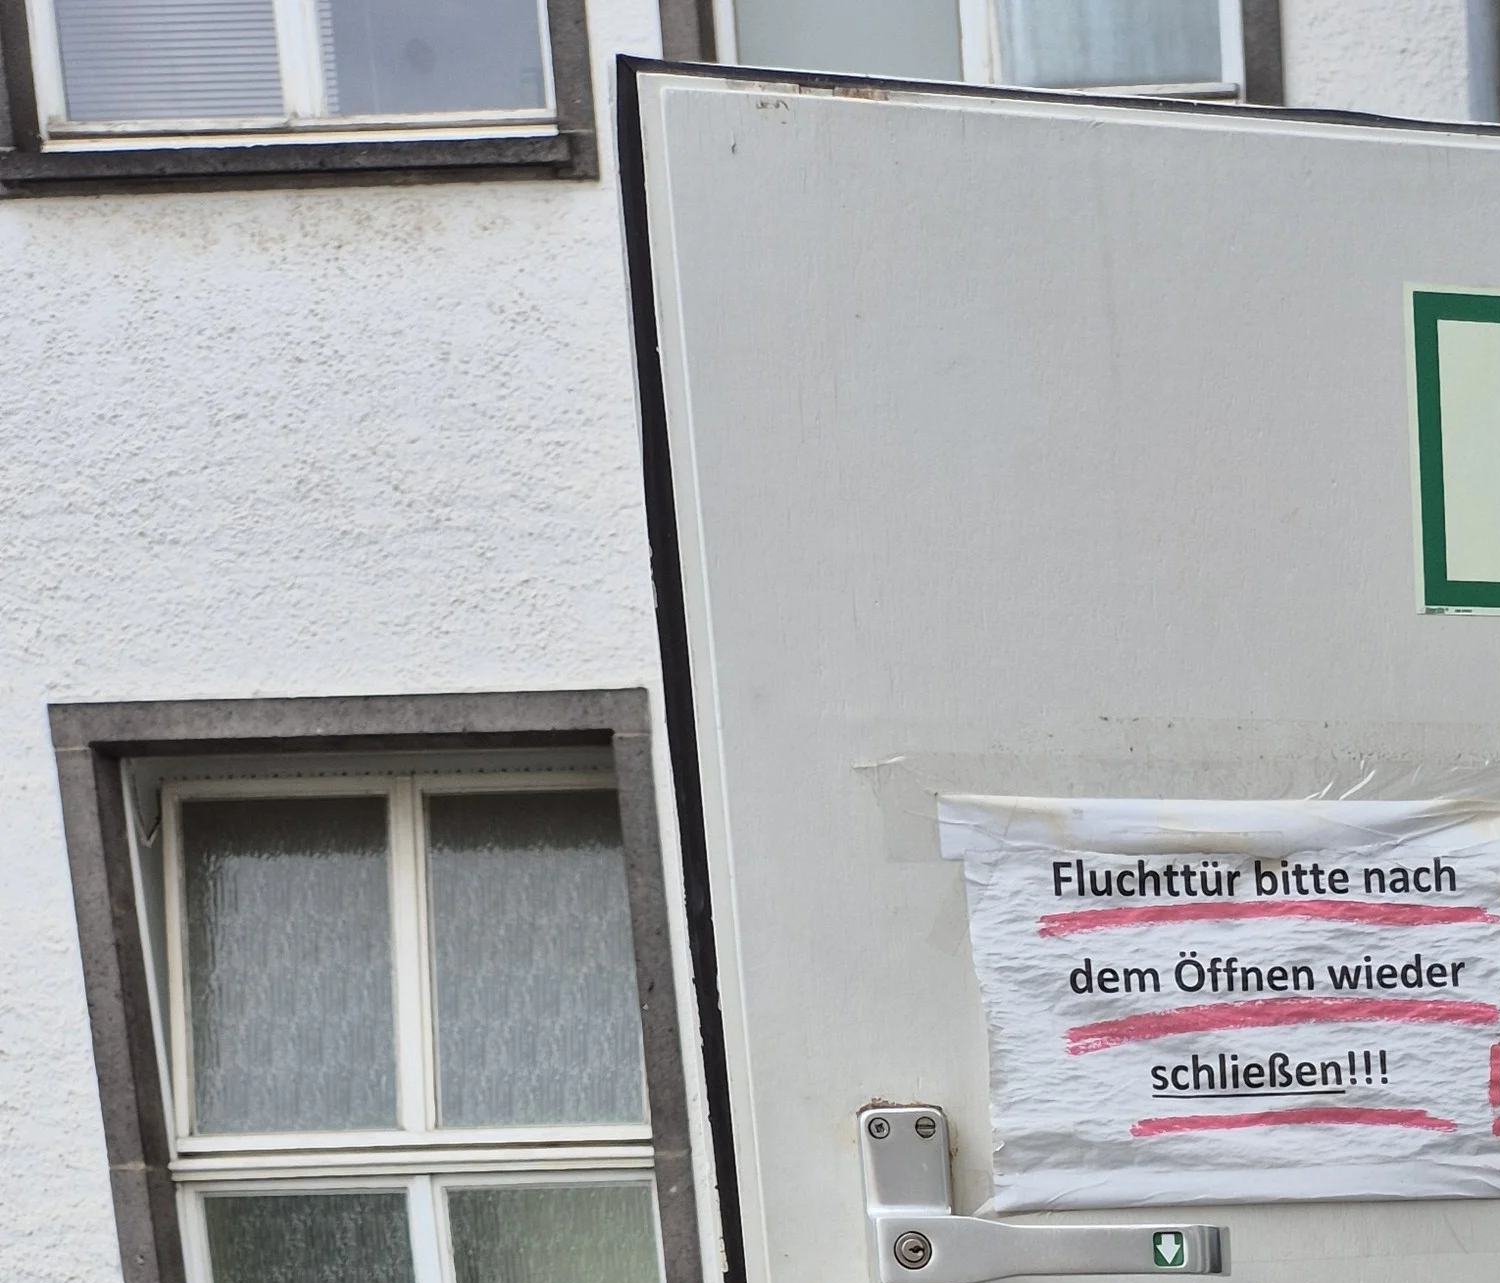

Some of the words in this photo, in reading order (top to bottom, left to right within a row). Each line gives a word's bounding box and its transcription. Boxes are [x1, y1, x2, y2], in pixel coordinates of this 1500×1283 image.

[1052, 860, 1241, 897] Fluchttür
[1254, 860, 1350, 897] bitte
[1363, 857, 1457, 894] nach
[1069, 958, 1161, 994] dem
[1174, 950, 1315, 992] Öffnen
[1327, 954, 1466, 990] wieder
[1150, 1050, 1389, 1091] schließen!!!
